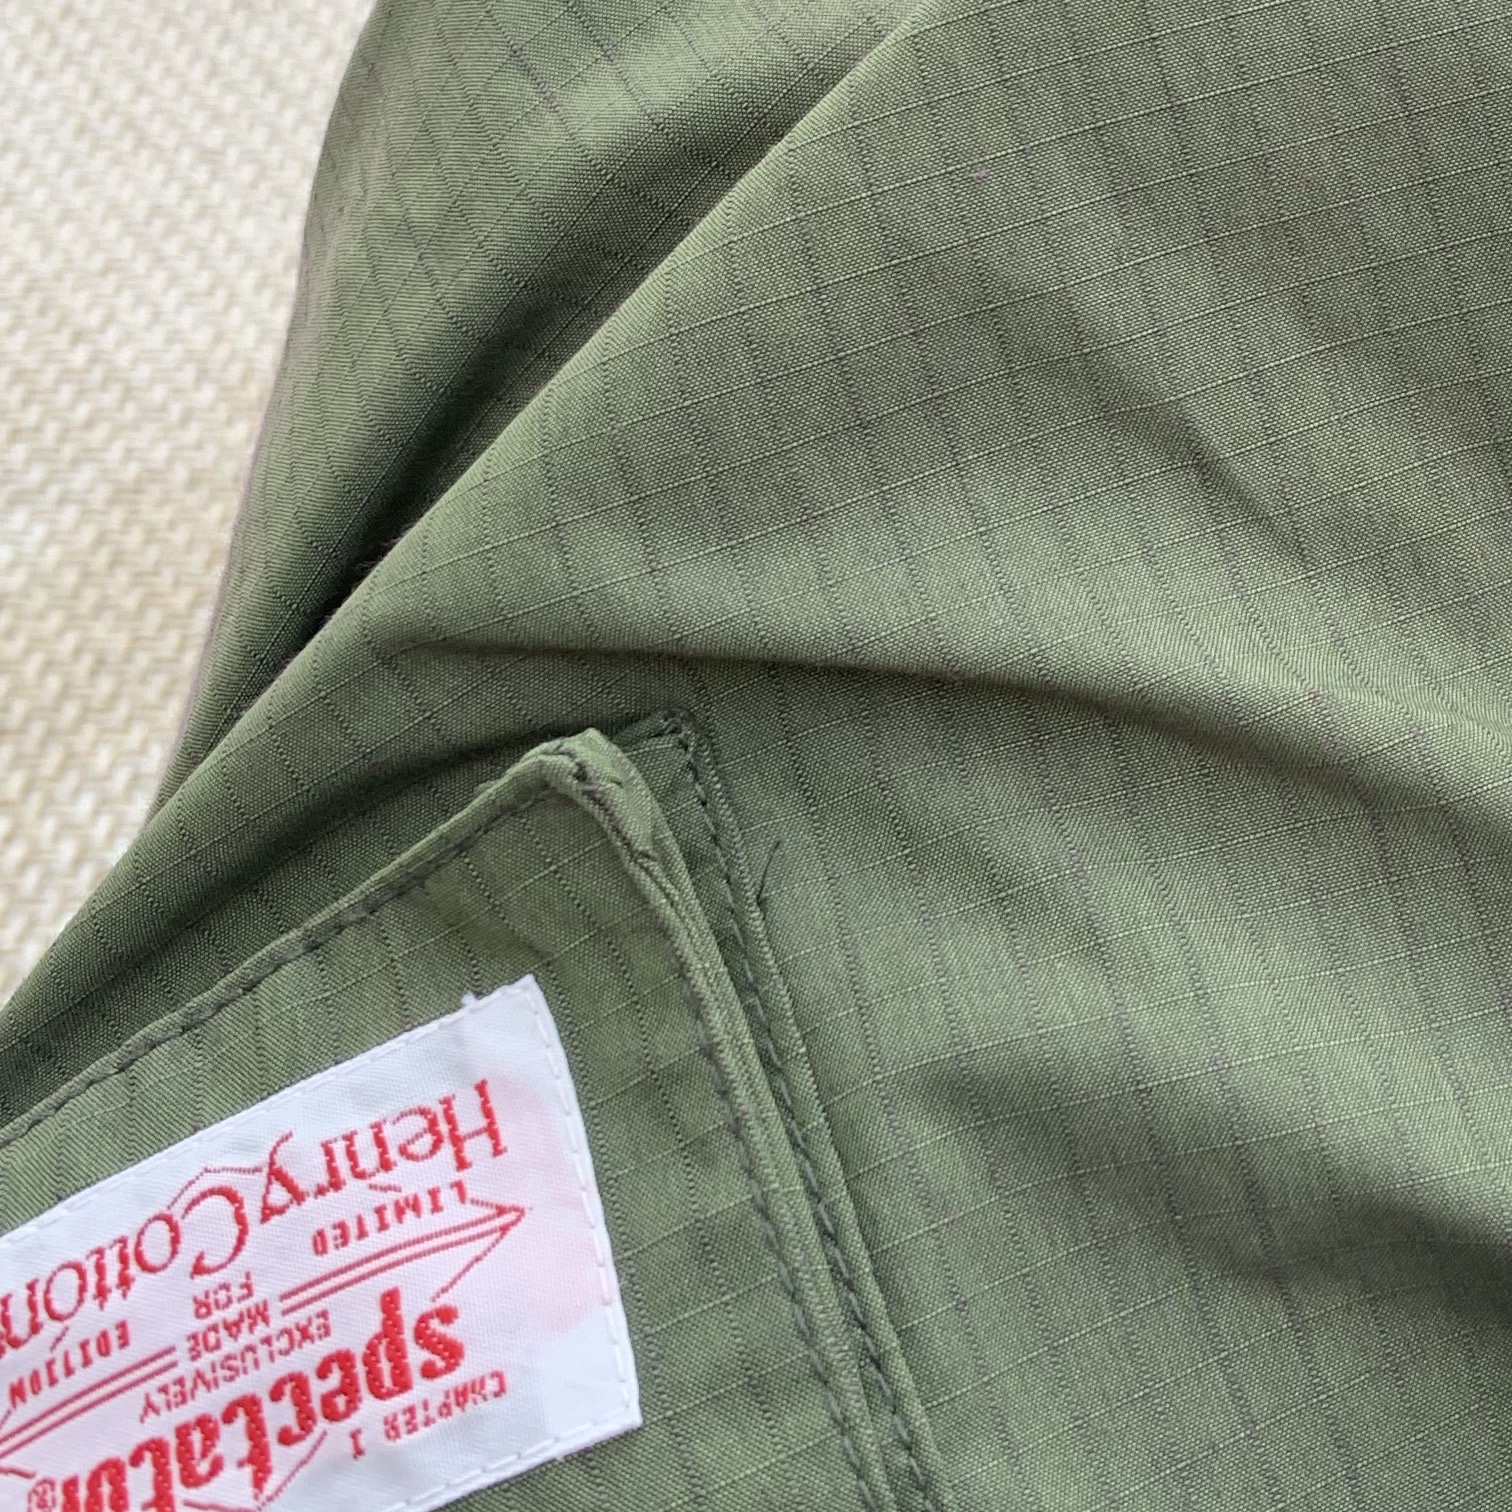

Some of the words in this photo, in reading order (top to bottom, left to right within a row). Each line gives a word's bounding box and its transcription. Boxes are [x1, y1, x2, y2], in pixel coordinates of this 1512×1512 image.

[310, 1178, 468, 1257] LIMITED
[0, 1185, 250, 1359] Cotton
[192, 1270, 255, 1320] FOR
[8, 1319, 131, 1409] EDITION
[139, 1307, 333, 1425] EXCLUSIVELY
[186, 1298, 271, 1363] MADE
[383, 1368, 509, 1442] CHAPTER
